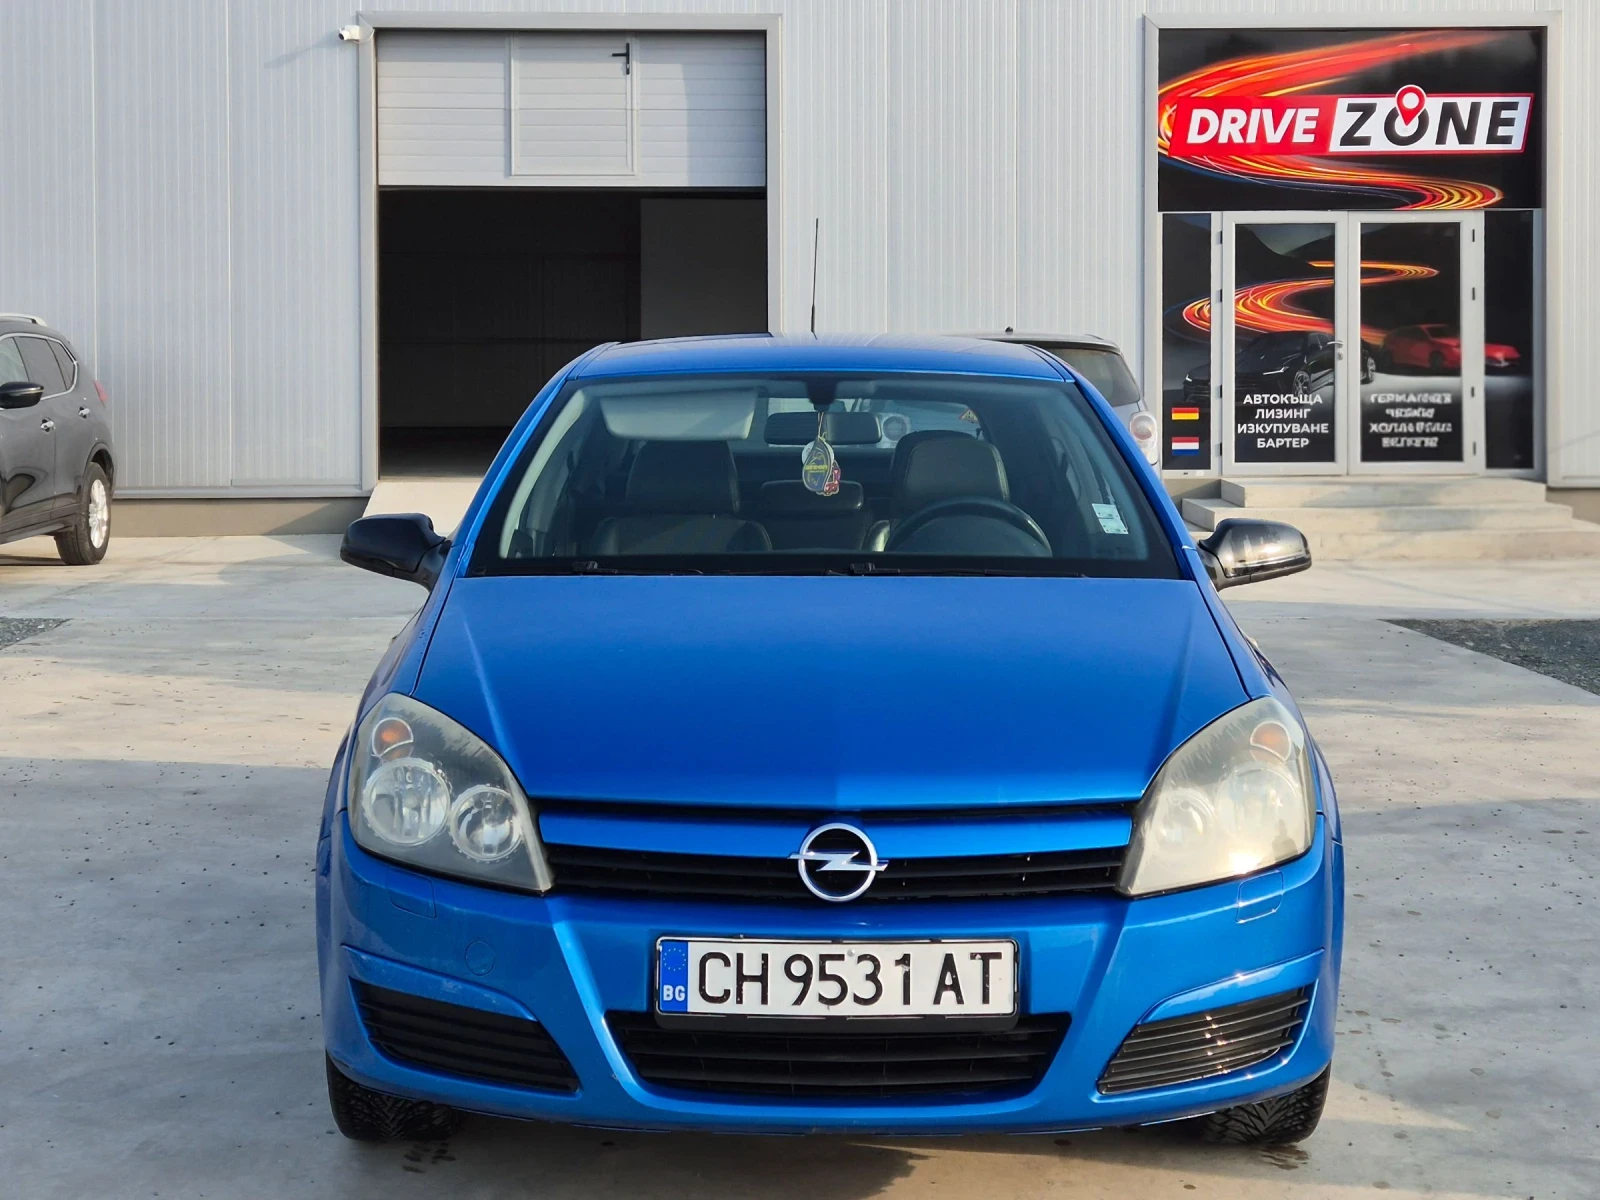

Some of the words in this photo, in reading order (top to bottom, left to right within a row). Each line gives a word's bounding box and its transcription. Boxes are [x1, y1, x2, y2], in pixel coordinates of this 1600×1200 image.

[1187, 108, 1319, 143] DRIVE
[1340, 101, 1519, 146] ZONE
[1243, 394, 1323, 405] АВТОКЪЩА
[1255, 408, 1311, 419] ЛИЗИНГ
[1237, 423, 1329, 434] ИЗКУПУВАНЕ
[1257, 437, 1309, 448] БАРТЕР
[699, 953, 769, 1005] CH
[784, 953, 911, 1006] 9531
[933, 952, 1002, 1005] AT
[663, 985, 686, 1002] BG
